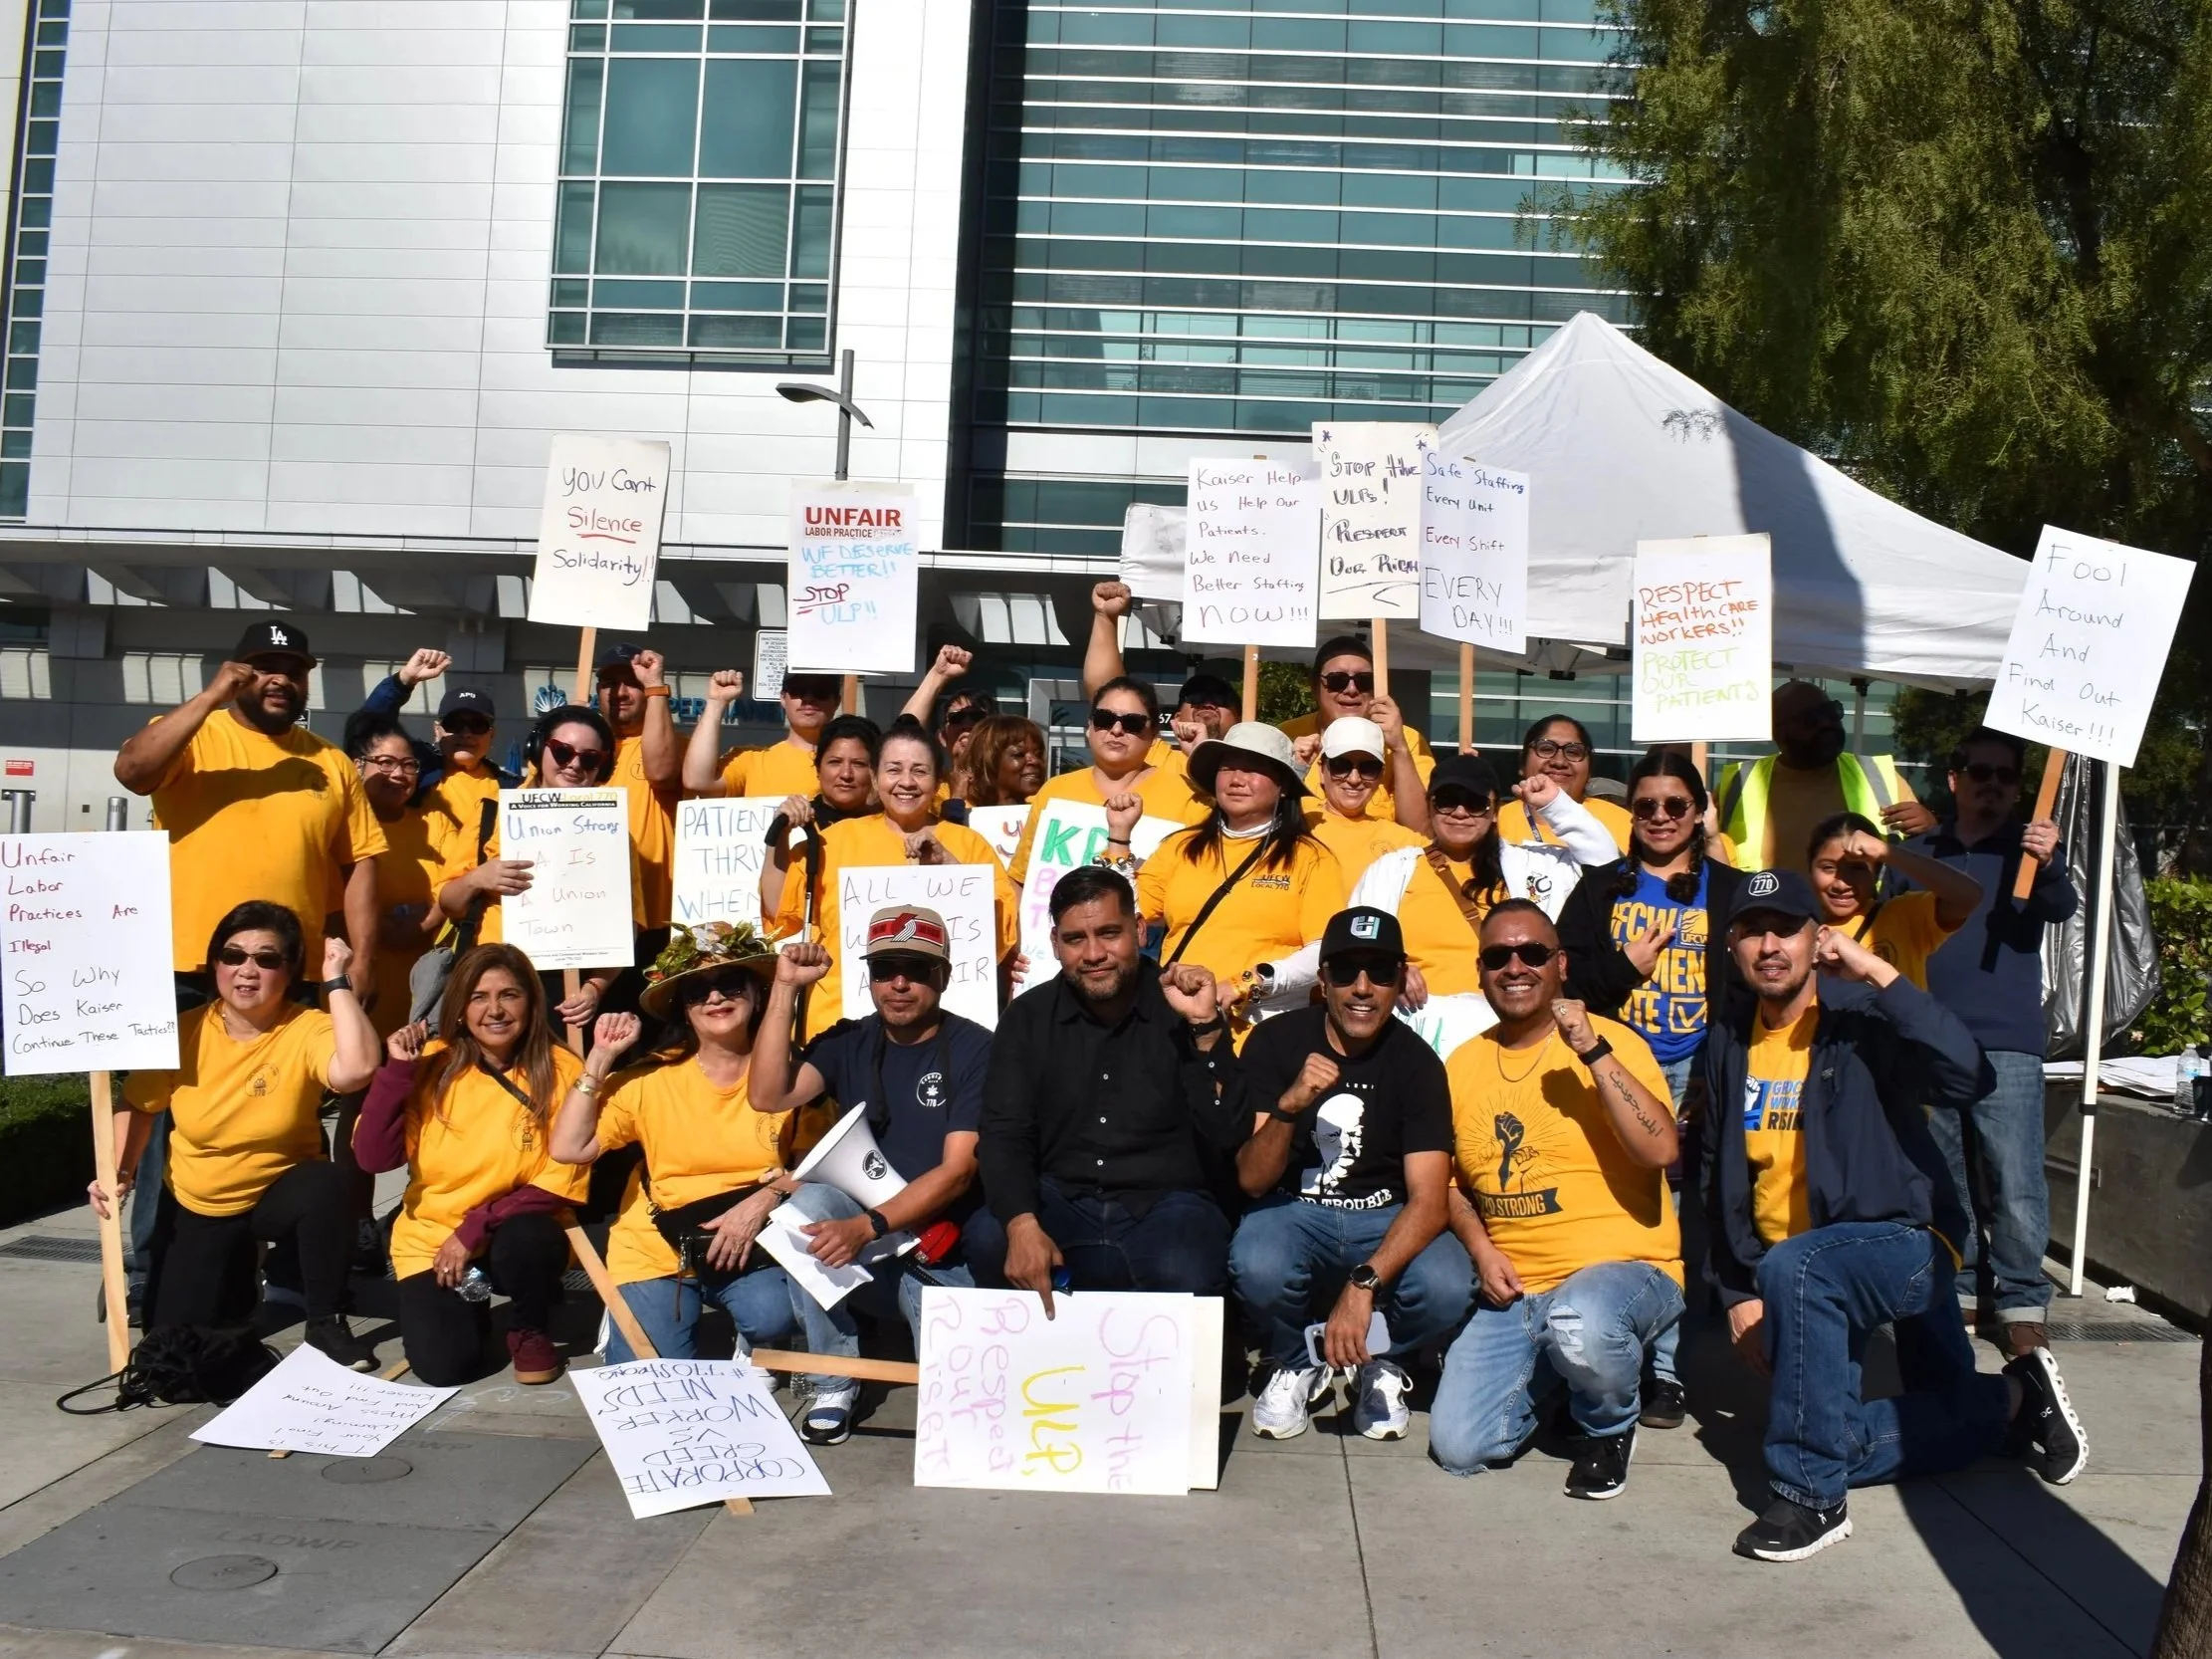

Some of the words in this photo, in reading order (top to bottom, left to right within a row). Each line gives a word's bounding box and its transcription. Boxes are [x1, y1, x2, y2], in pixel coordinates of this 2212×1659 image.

[1197, 467, 1254, 490] Kaiser
[1267, 470, 1302, 485] Help
[1427, 452, 1462, 479] Safe
[1474, 469, 1525, 494] Staffing
[1238, 496, 1267, 510] Help
[1427, 486, 1459, 510] Every
[567, 507, 642, 533] Silence
[805, 507, 901, 527] UNFAIR
[805, 527, 831, 537] LABOR
[833, 528, 872, 538] PRACTICE
[1426, 526, 1460, 549] Every
[1468, 536, 1504, 552] Shift
[1190, 550, 1217, 565] We
[2047, 544, 2126, 587] Fool
[793, 584, 849, 601] STOP
[1193, 575, 1242, 592] Better
[1425, 567, 1502, 607] EVERY
[1639, 582, 1742, 611] RESPECT
[2035, 589, 2123, 628] Around
[271, 626, 288, 645] LA
[2039, 632, 2090, 662] And
[1643, 647, 1740, 676] PROTECT
[1642, 672, 1698, 694] OUR
[2009, 662, 2055, 691] Find
[2079, 683, 2122, 707] Out
[1657, 680, 1759, 713] PATIENTS
[522, 792, 561, 804] UFCW
[508, 815, 562, 840] Union
[572, 815, 619, 834] Strong
[1, 841, 76, 868] Unfair
[567, 848, 596, 865] Is
[692, 844, 766, 875] THRI
[8, 875, 64, 895] Labor
[553, 887, 607, 903] Union
[844, 876, 898, 910] ALL
[927, 876, 982, 898] WE
[1754, 879, 1772, 891] 770
[10, 903, 83, 921] Practices
[111, 904, 138, 919] Are
[519, 919, 573, 937] Town
[947, 916, 981, 941] IS
[15, 969, 46, 997] So
[73, 966, 120, 988] Why
[949, 957, 990, 983] IR
[19, 1003, 61, 1026] Does
[76, 999, 123, 1018] Kaiser
[12, 1033, 75, 1055] Continue
[79, 1031, 119, 1046] These
[1321, 1189, 1393, 1210] TROUBLE
[1497, 1194, 1546, 1217] STRONG
[1091, 1306, 1181, 1416] Stop
[597, 1377, 718, 1416] NEEDS
[611, 1394, 777, 1431] WORKER
[669, 1425, 727, 1446] VS
[305, 1443, 370, 1454] This
[642, 1442, 766, 1466] GREED
[623, 1458, 805, 1495] CORPORATE
